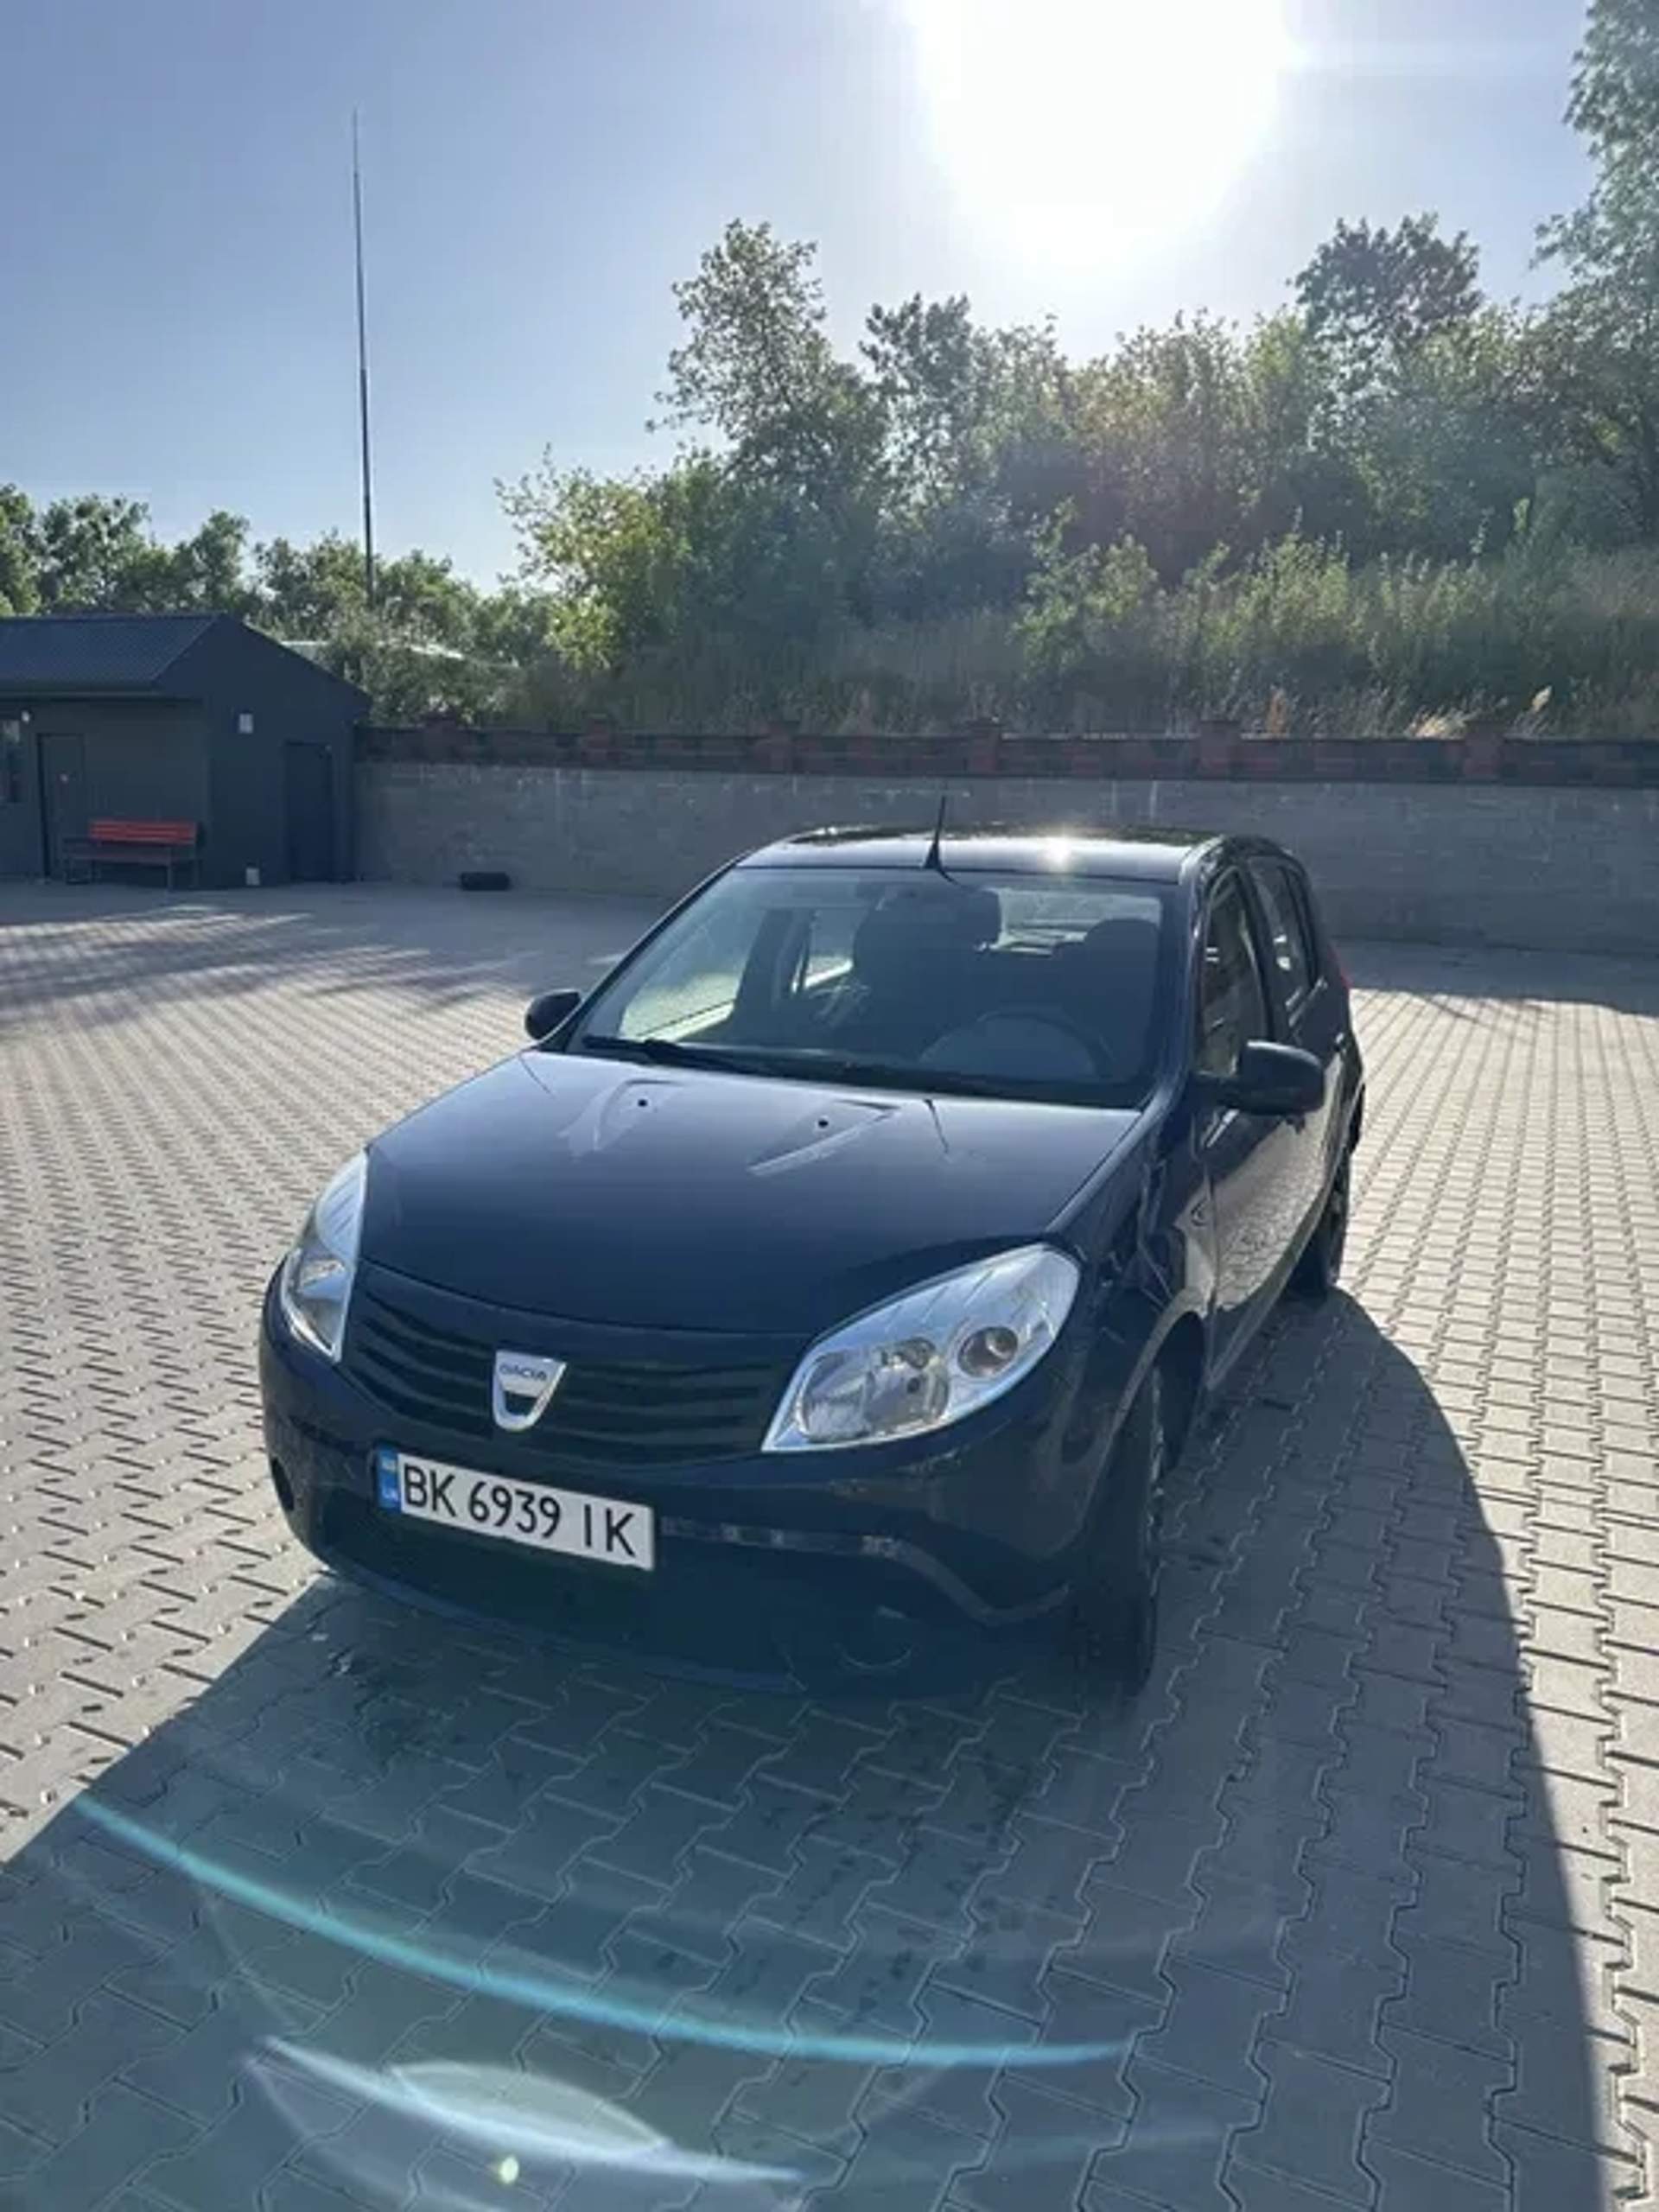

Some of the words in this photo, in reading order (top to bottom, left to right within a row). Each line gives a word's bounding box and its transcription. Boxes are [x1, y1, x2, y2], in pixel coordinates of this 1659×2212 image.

[403, 1464, 456, 1517] BK
[467, 1481, 562, 1539] 6939
[583, 1503, 636, 1558] IK
